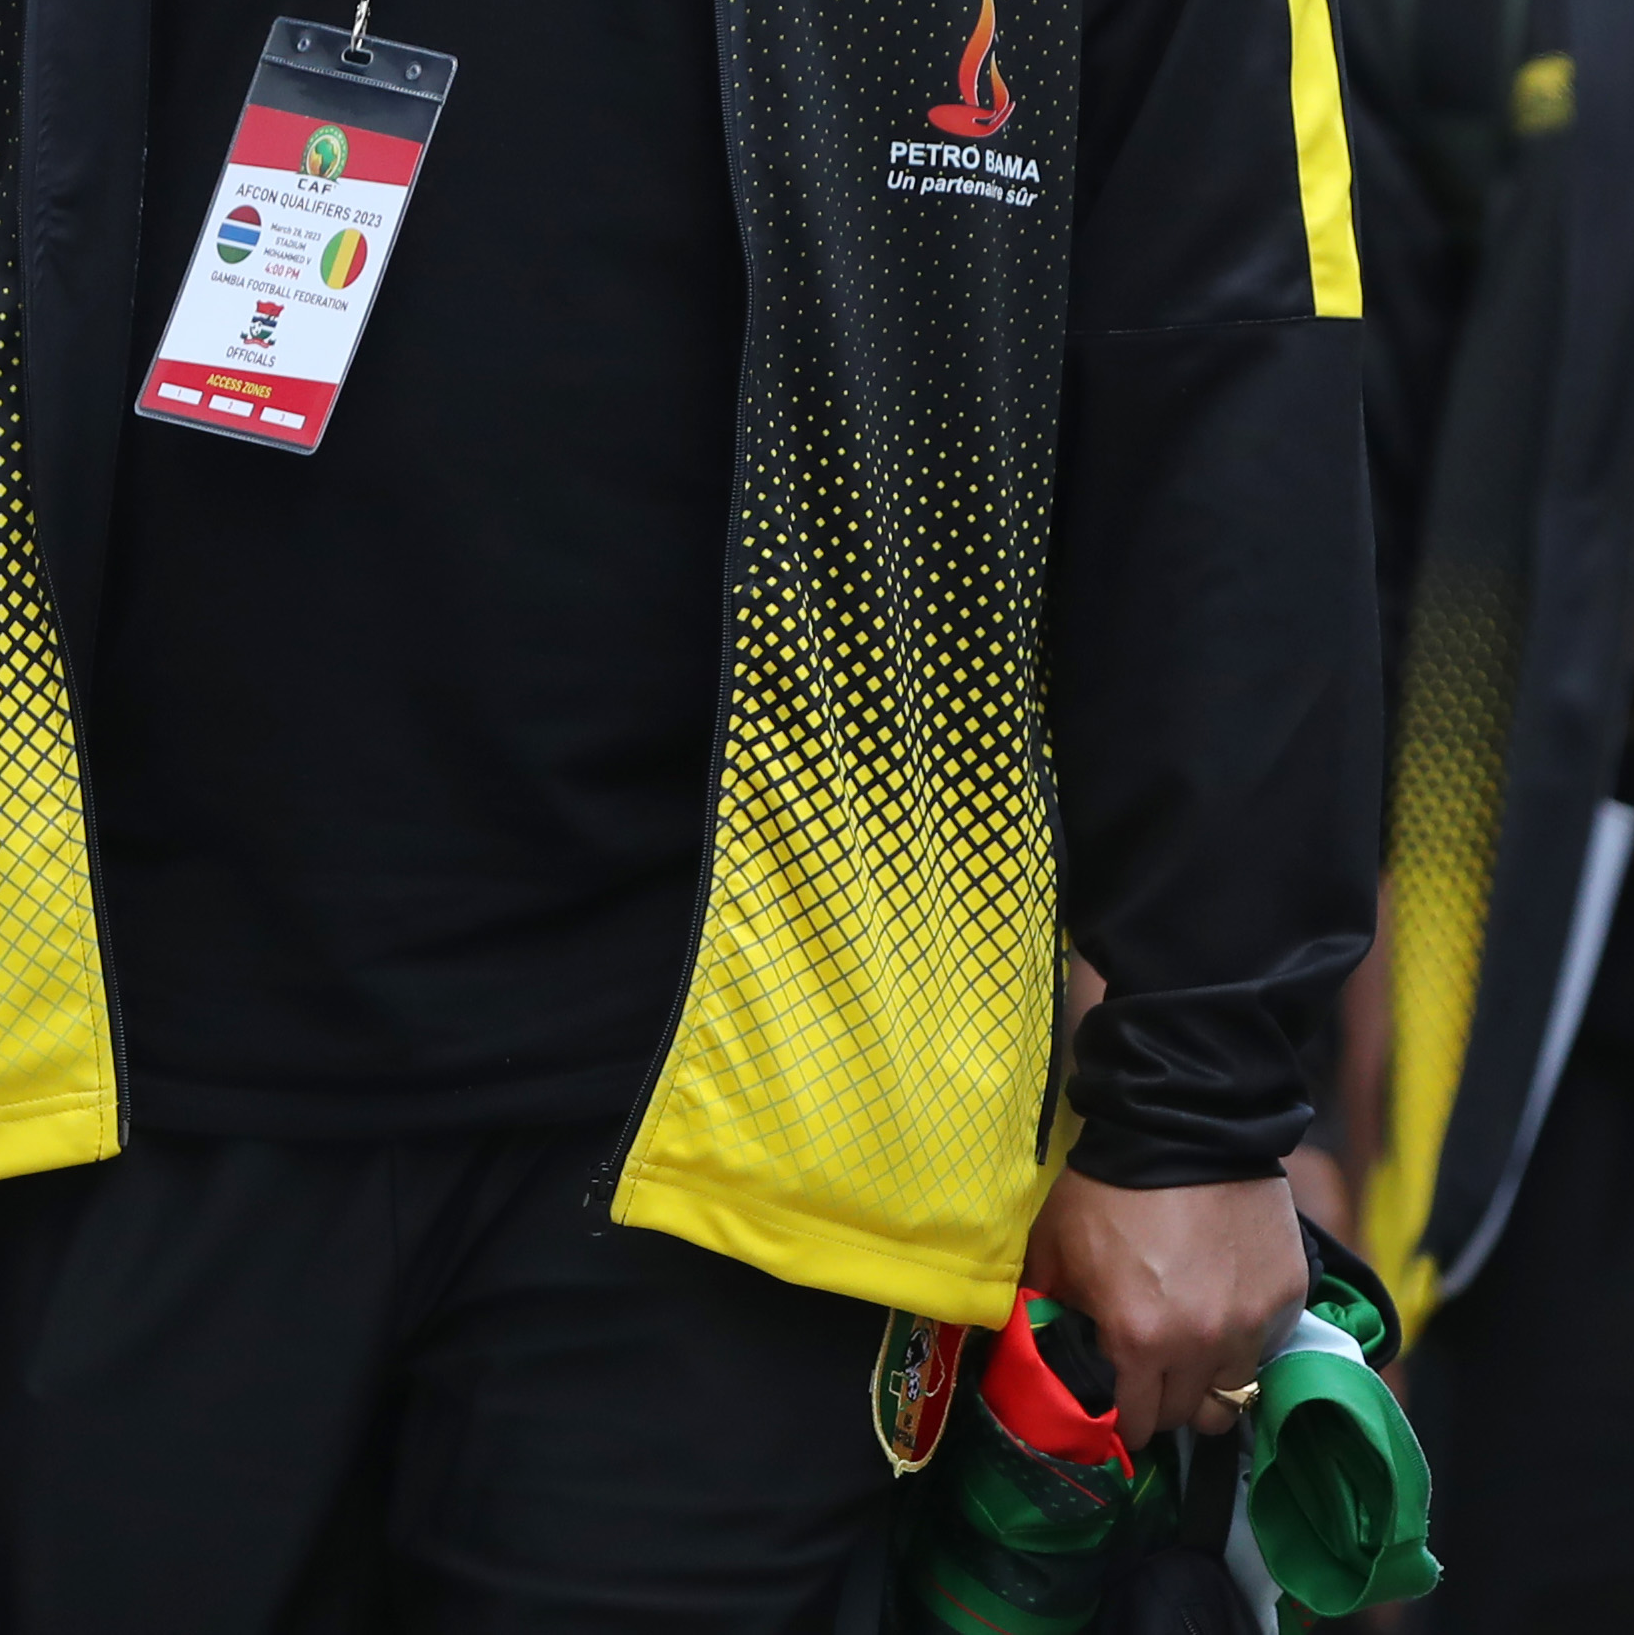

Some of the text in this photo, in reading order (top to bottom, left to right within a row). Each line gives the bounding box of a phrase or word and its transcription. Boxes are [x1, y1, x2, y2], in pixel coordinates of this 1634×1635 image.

[890, 141, 1041, 183] PETRO BAMA
[297, 178, 332, 195] CAF
[887, 170, 1038, 207] Un partenaire sûr
[235, 182, 383, 228] AFCON QUALIFIERS 2023
[270, 222, 292, 235] March
[303, 229, 322, 241] 2023
[275, 236, 307, 251] STADIUM
[263, 247, 312, 265] MOHAMMED V
[265, 262, 300, 280] 4:00 PM
[210, 270, 350, 312] GAMBIA FOOTBALL FEDERATION
[226, 346, 277, 367] OFFICIALS
[206, 373, 273, 399] ACCESS ZONES
